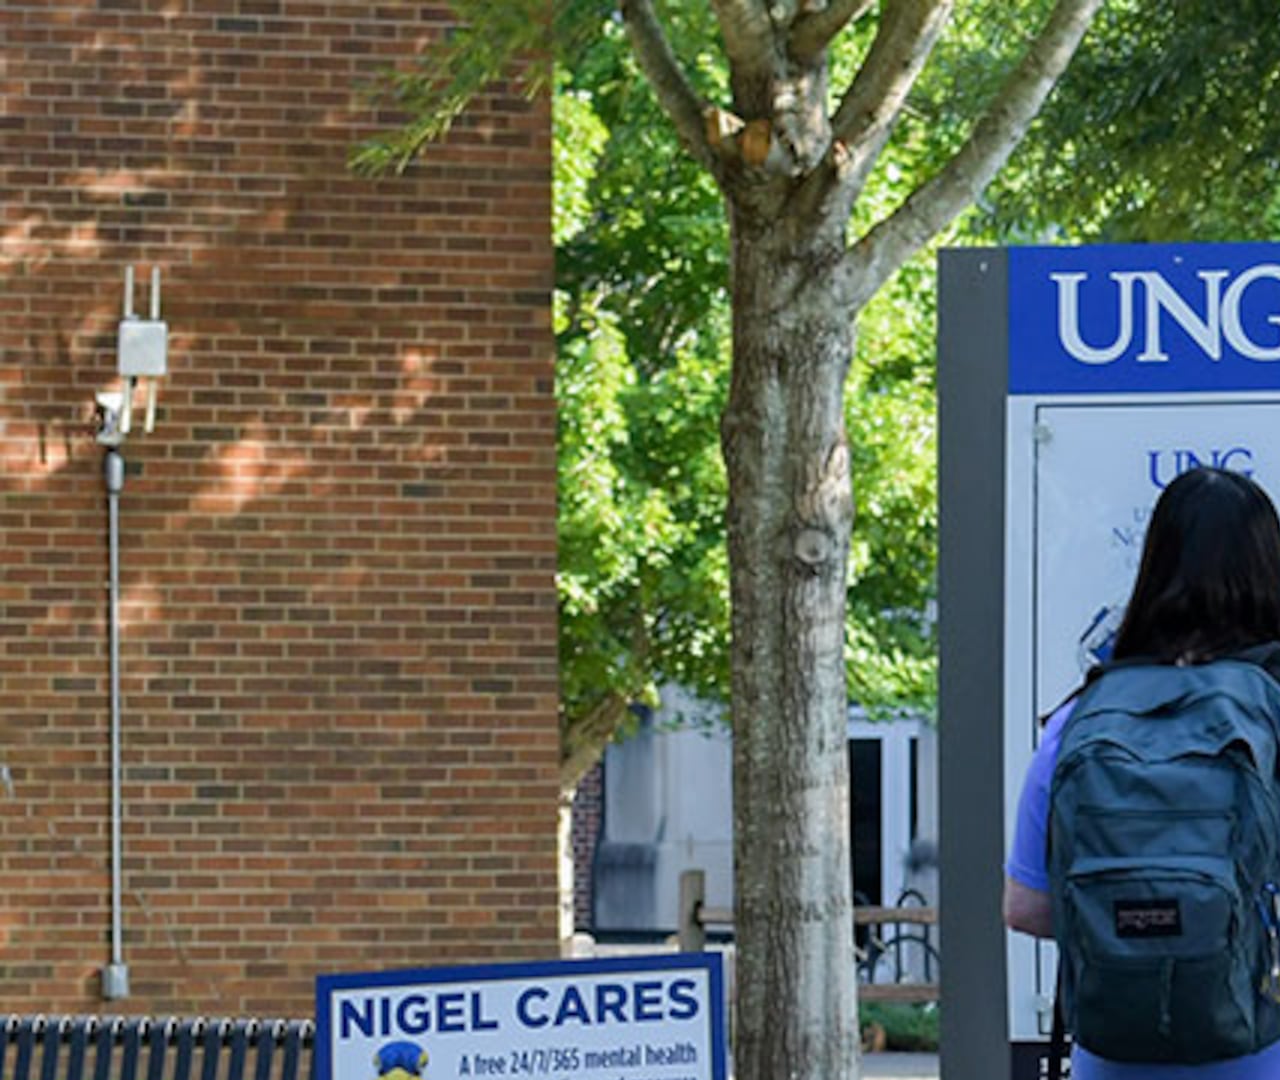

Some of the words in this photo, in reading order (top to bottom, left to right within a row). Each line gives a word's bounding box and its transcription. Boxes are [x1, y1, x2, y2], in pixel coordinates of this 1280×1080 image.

[340, 991, 498, 1039] NIGEL
[515, 979, 699, 1029] CARES
[458, 1055, 471, 1076] A
[474, 1053, 506, 1075] free
[509, 1048, 580, 1075] 24/7/365
[585, 1045, 641, 1069] mental
[645, 1042, 697, 1065] health
